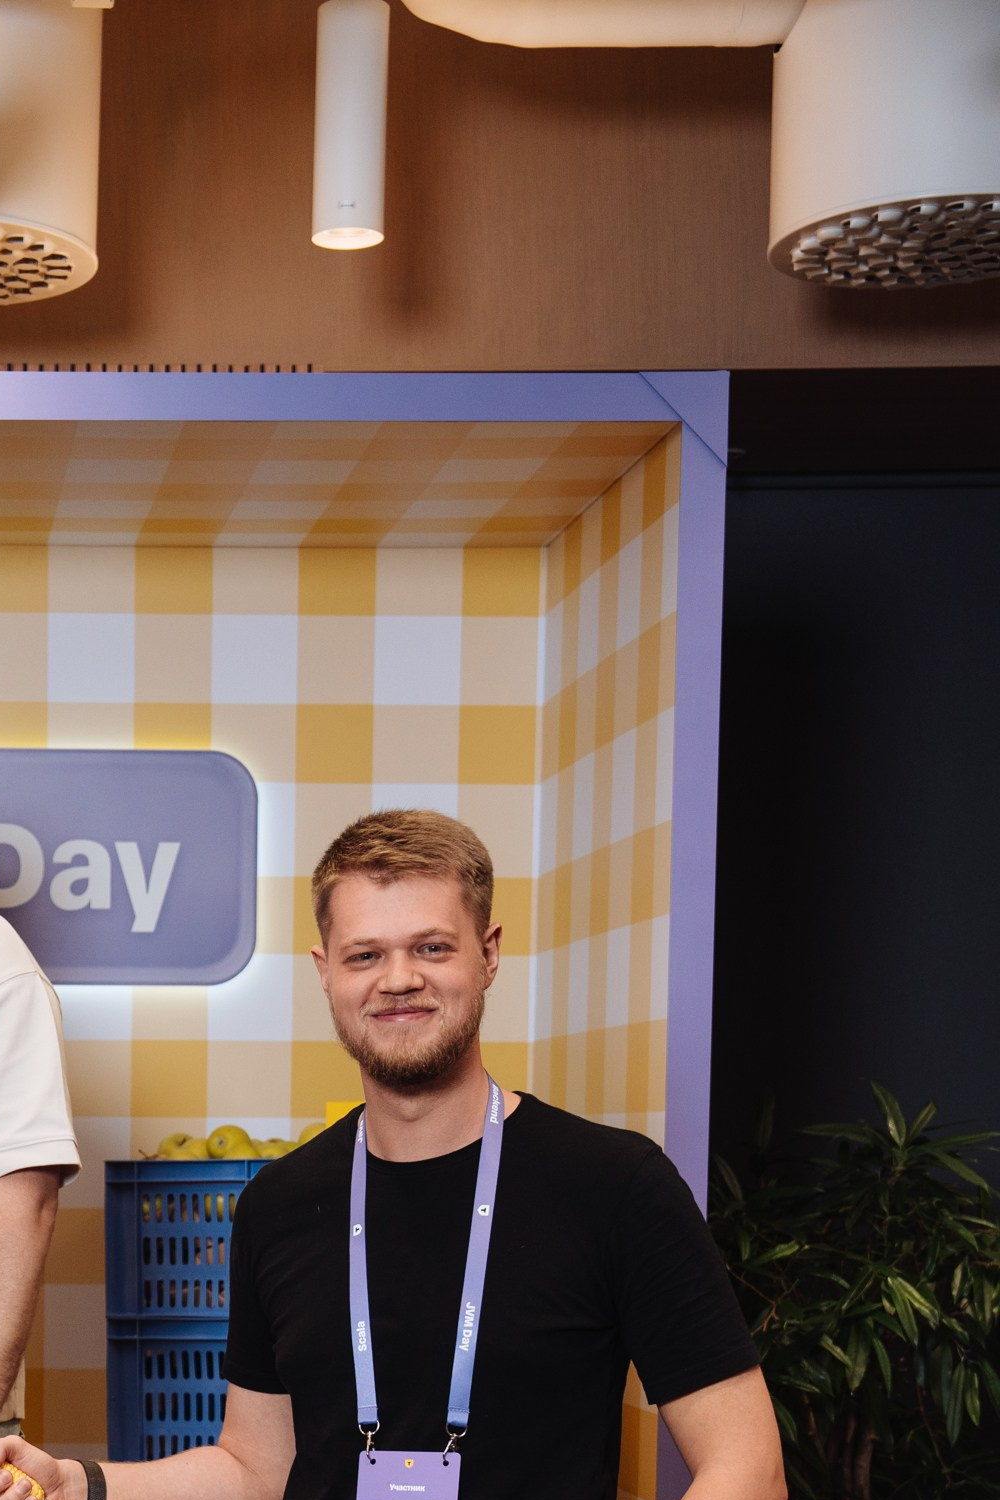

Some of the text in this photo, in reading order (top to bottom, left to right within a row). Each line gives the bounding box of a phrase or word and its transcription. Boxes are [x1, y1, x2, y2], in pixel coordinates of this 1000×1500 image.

[355, 1320, 367, 1352] Scala
[458, 1301, 476, 1352] JVM Day
[389, 1483, 426, 1492] Участник
